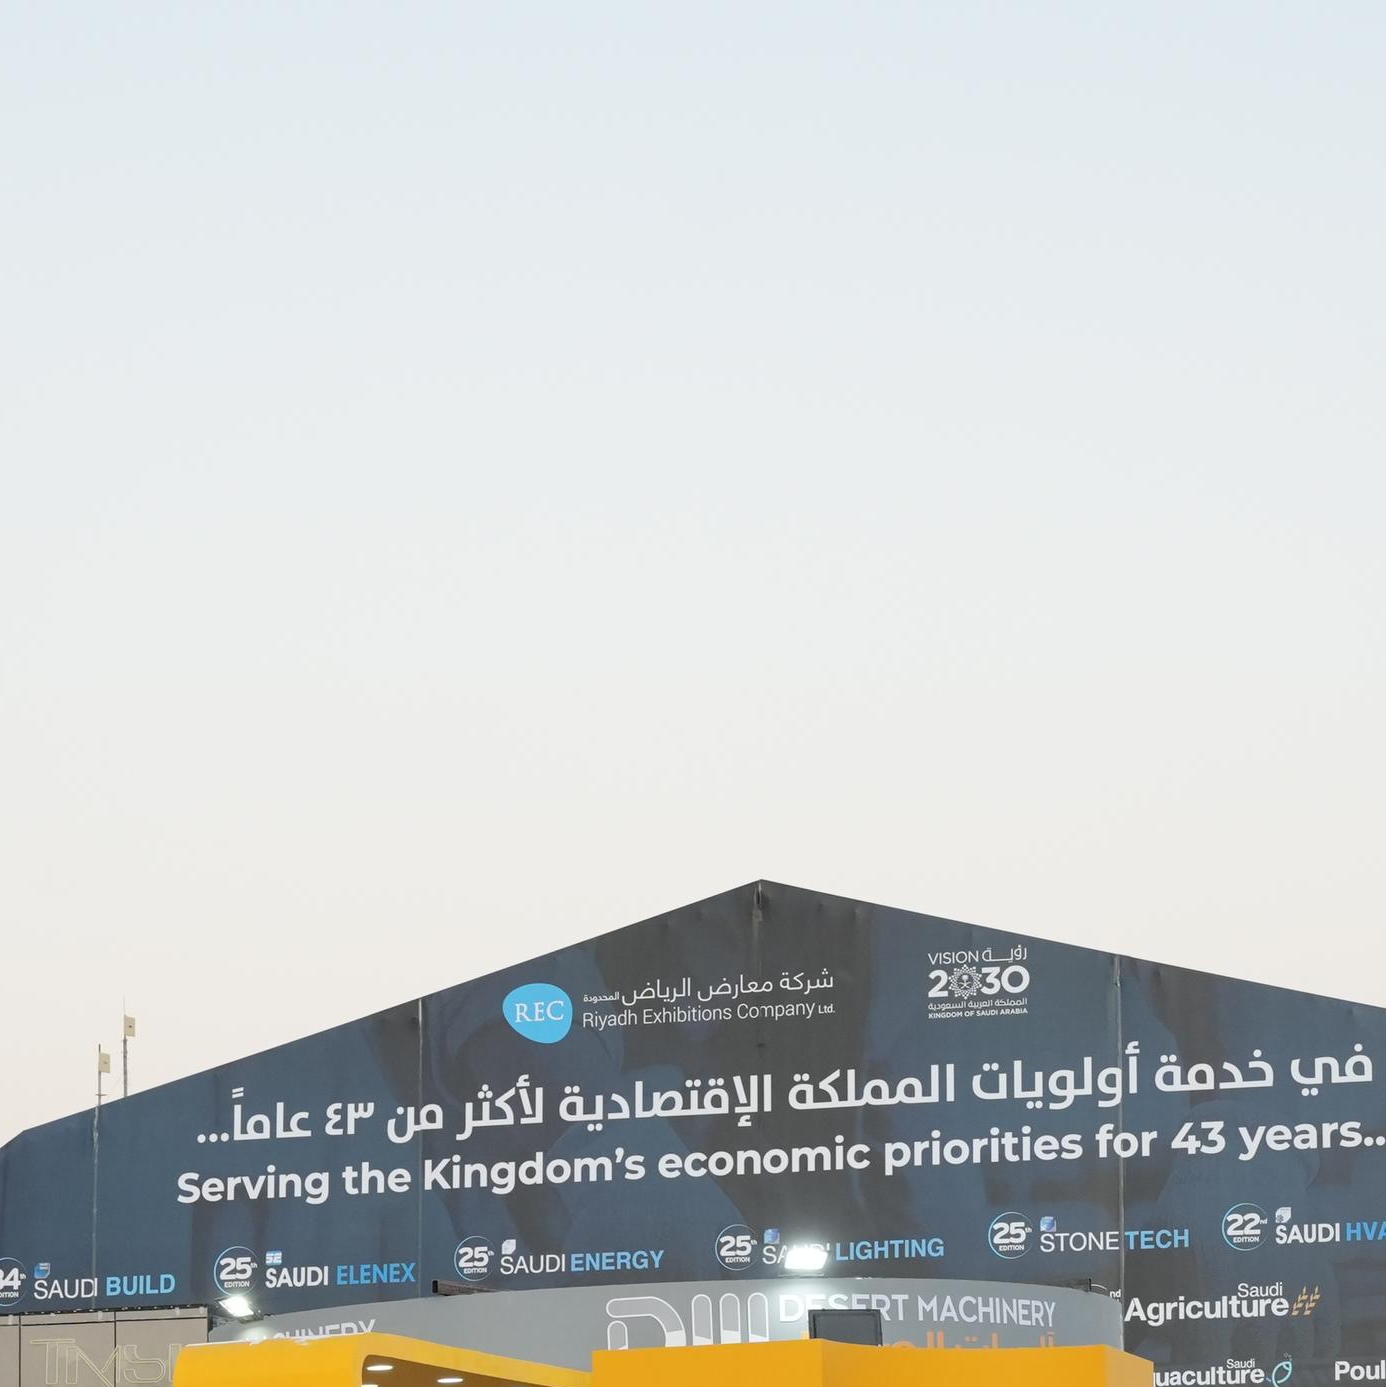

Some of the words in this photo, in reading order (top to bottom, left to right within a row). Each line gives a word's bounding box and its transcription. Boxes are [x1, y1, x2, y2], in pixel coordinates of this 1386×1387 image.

[927, 950, 979, 965] VISION
[621, 977, 691, 1006] الرياض
[698, 973, 773, 1002] معارض
[779, 967, 834, 993] شركة
[514, 1000, 565, 1024] REC
[582, 1008, 638, 1030] Riyadh
[643, 1003, 732, 1025] Exhibitions
[736, 1000, 816, 1024] Company
[818, 1004, 835, 1014] Ltd.
[928, 1010, 963, 1020] KINGDOM
[964, 1010, 975, 1018] OF
[976, 1009, 999, 1017] SAUDI
[999, 1007, 1029, 1016] ARABIA
[972, 1040, 1140, 1110] أولويات
[1154, 1048, 1275, 1092] خدمة
[1290, 1043, 1373, 1096] في
[788, 1063, 955, 1111] المملكة
[456, 1073, 544, 1141] لأكثر
[558, 1073, 772, 1132] الإقتصادية
[387, 1102, 444, 1144] من
[176, 1164, 330, 1206] Serving
[342, 1161, 412, 1196] the
[657, 1134, 871, 1177] economic
[884, 1125, 1083, 1176] priorities
[1095, 1123, 1158, 1158] for
[1170, 1120, 1226, 1156] 43
[1039, 1231, 1120, 1252] STONE
[1125, 1228, 1191, 1250] TECH
[1232, 1235, 1260, 1244] EDITION
[1274, 1221, 1341, 1245] SAUDI
[724, 1255, 751, 1264] EDITION
[835, 1237, 945, 1262] LIGHTING
[998, 1243, 1025, 1252] EDITION
[265, 1265, 330, 1289] SAUDI
[336, 1262, 417, 1286] ELENEX
[462, 1266, 488, 1275] EDITION
[499, 1253, 566, 1276] SAUDI
[570, 1249, 665, 1273] ENERGY
[33, 1277, 98, 1301] SAUDI
[105, 1273, 176, 1297] BUILD
[223, 1280, 251, 1289] EDITION
[1237, 1281, 1283, 1298] Saudi
[917, 1295, 1056, 1327] MACHINERY
[1124, 1294, 1290, 1327] Agriculture
[1226, 1358, 1256, 1369] Saudi
